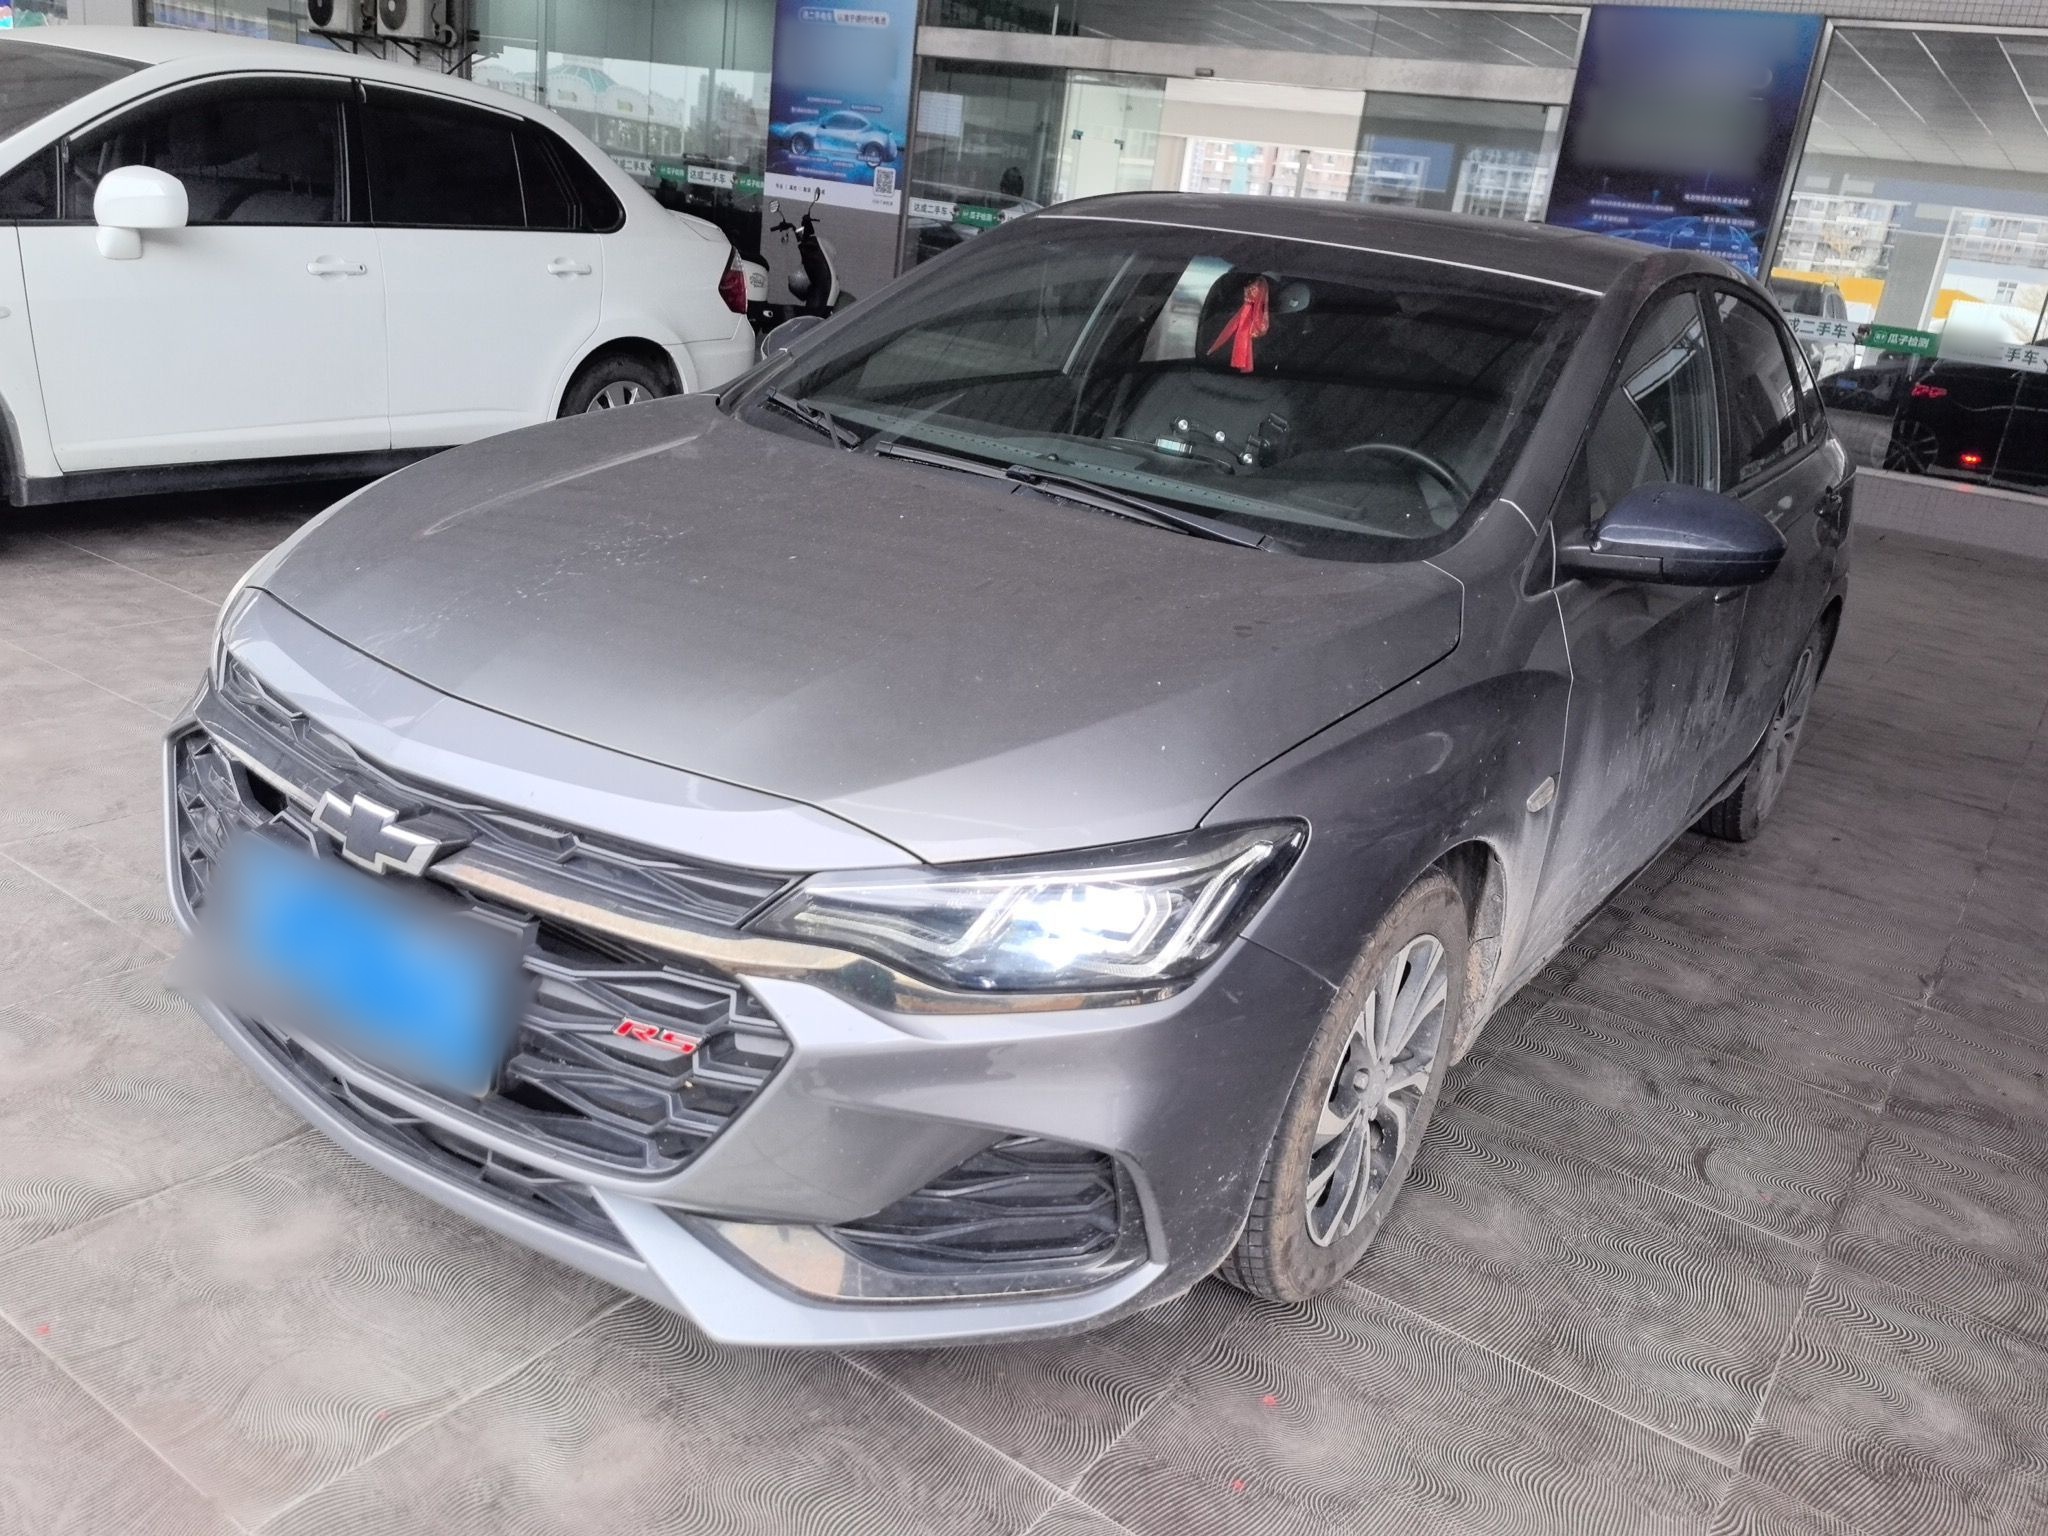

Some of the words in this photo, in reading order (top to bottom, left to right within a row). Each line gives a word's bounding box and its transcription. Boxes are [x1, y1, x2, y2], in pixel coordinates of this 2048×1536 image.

[689, 170, 726, 184] 达成二手车
[913, 203, 948, 215] 达成二手车
[1887, 333, 1930, 348] 瓜子检测
[613, 1017, 702, 1054] RS
